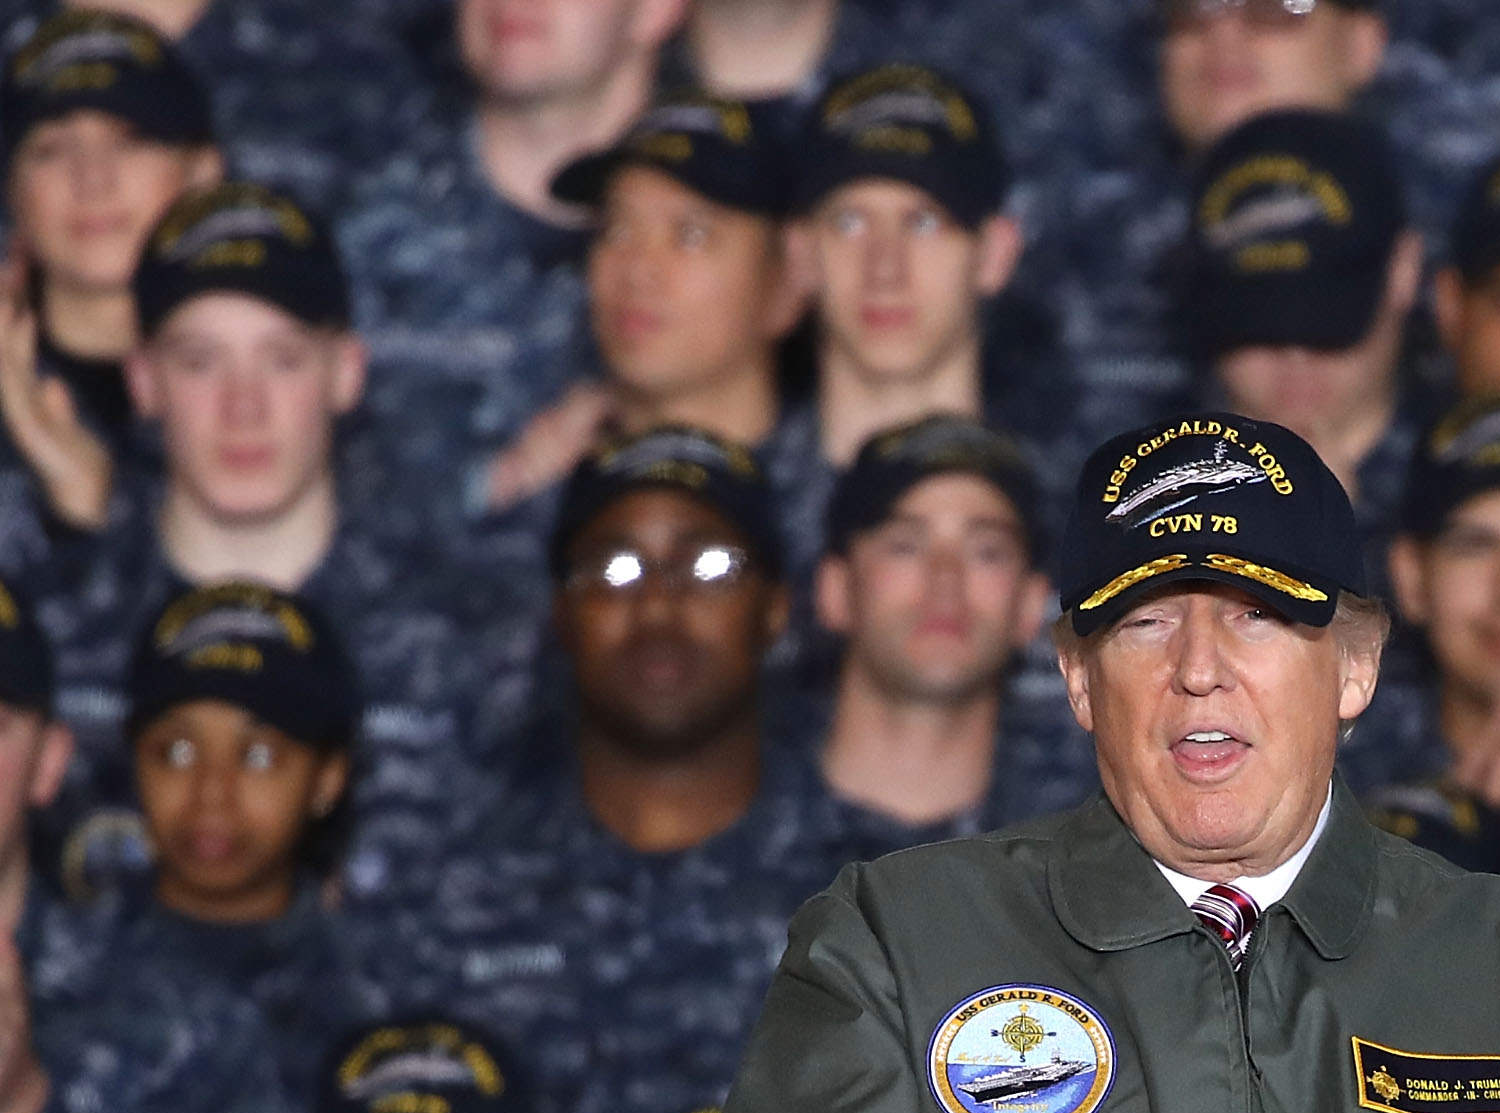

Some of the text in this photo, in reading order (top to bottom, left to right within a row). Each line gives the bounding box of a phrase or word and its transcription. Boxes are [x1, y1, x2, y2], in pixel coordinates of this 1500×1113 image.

[1102, 420, 1295, 503] USS GERALD R. FORD
[1149, 514, 1239, 537] CVN 78
[956, 991, 1089, 1024] USS GERALD R. FORD
[1406, 1078, 1449, 1090] DONALD
[1454, 1080, 1464, 1090] J.
[1408, 1090, 1459, 1102] COMMANDER
